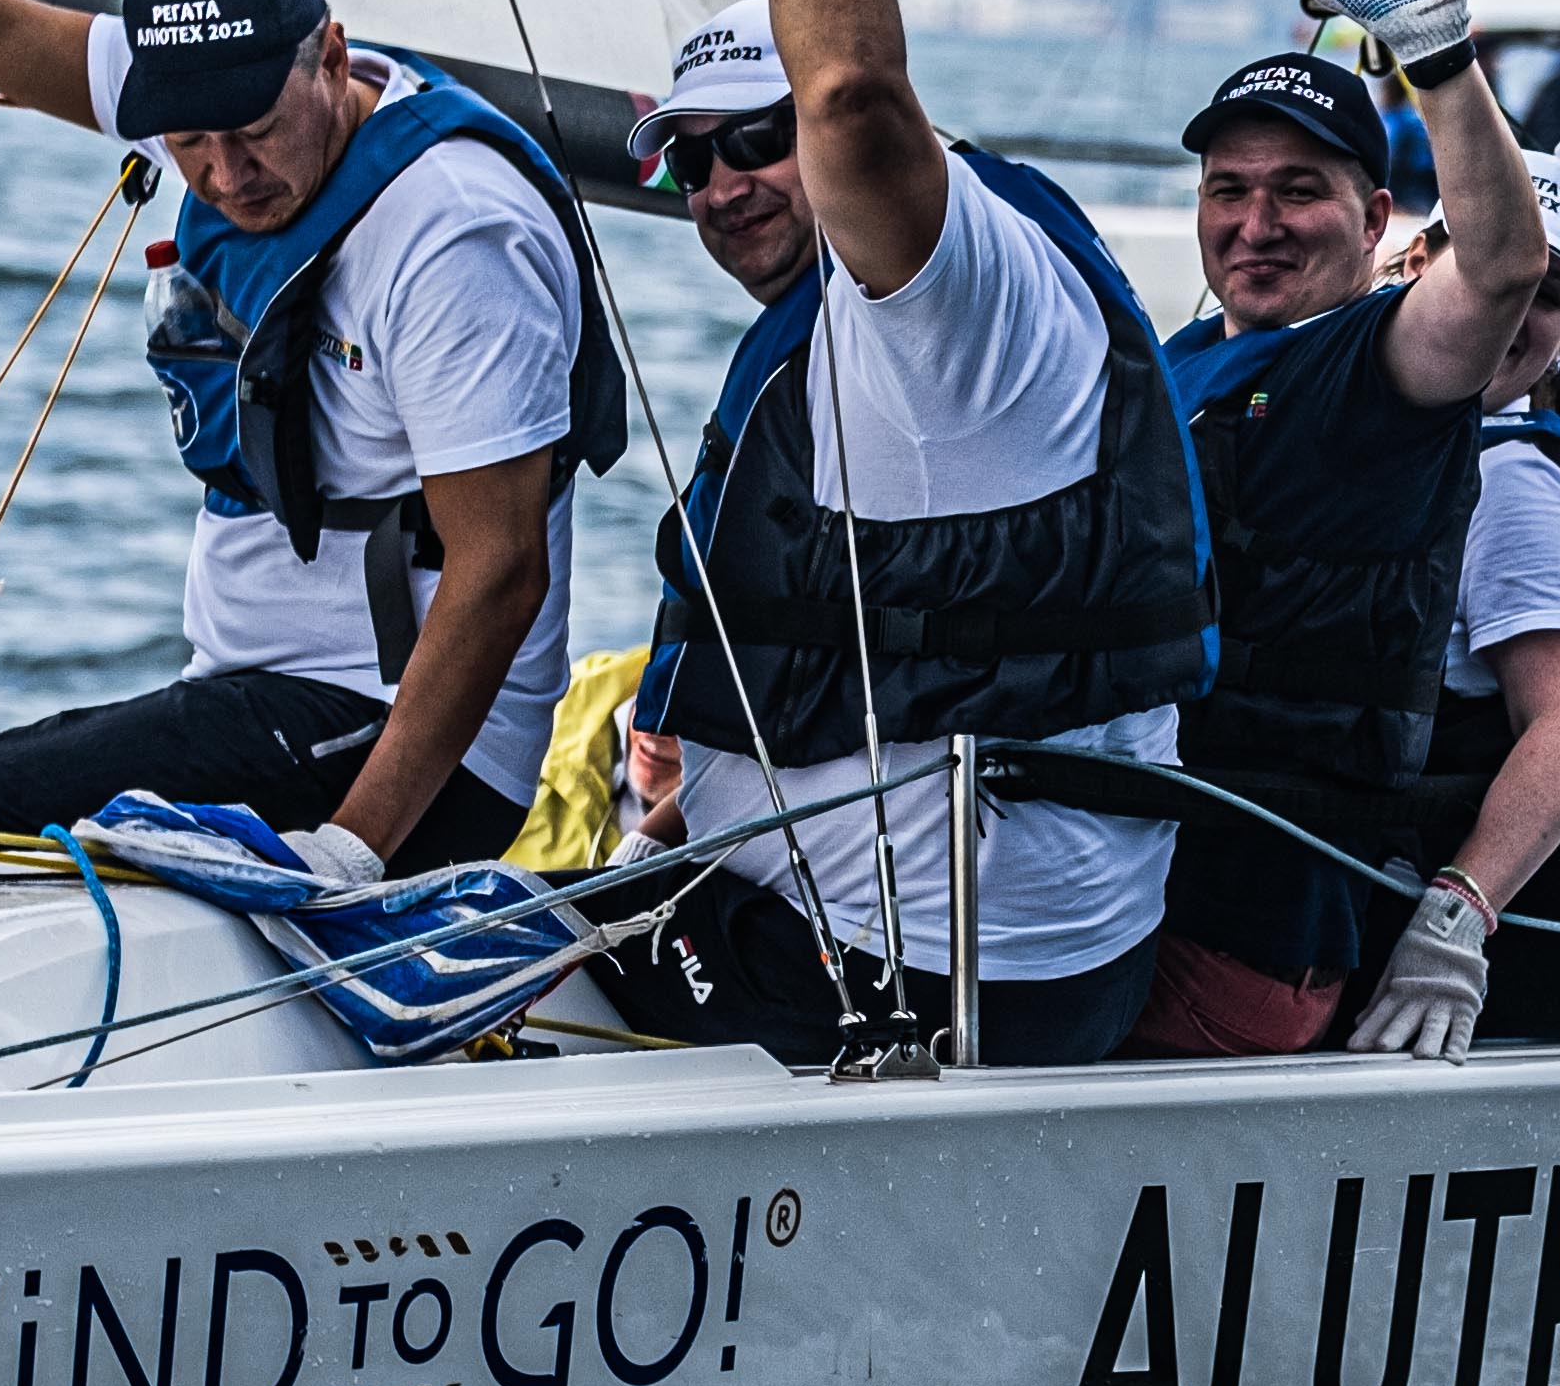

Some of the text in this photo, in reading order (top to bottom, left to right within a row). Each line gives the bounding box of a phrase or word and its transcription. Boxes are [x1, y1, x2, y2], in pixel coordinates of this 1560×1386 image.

[152, 0, 221, 25] РЕГАТА
[207, 18, 255, 41] 2022
[719, 46, 762, 62] 2022
[1243, 66, 1312, 85] РЕГАТА
[1222, 79, 1335, 111] ЛЮТЕХ 2022
[672, 935, 714, 1005] FILA
[337, 1277, 454, 1371] TO
